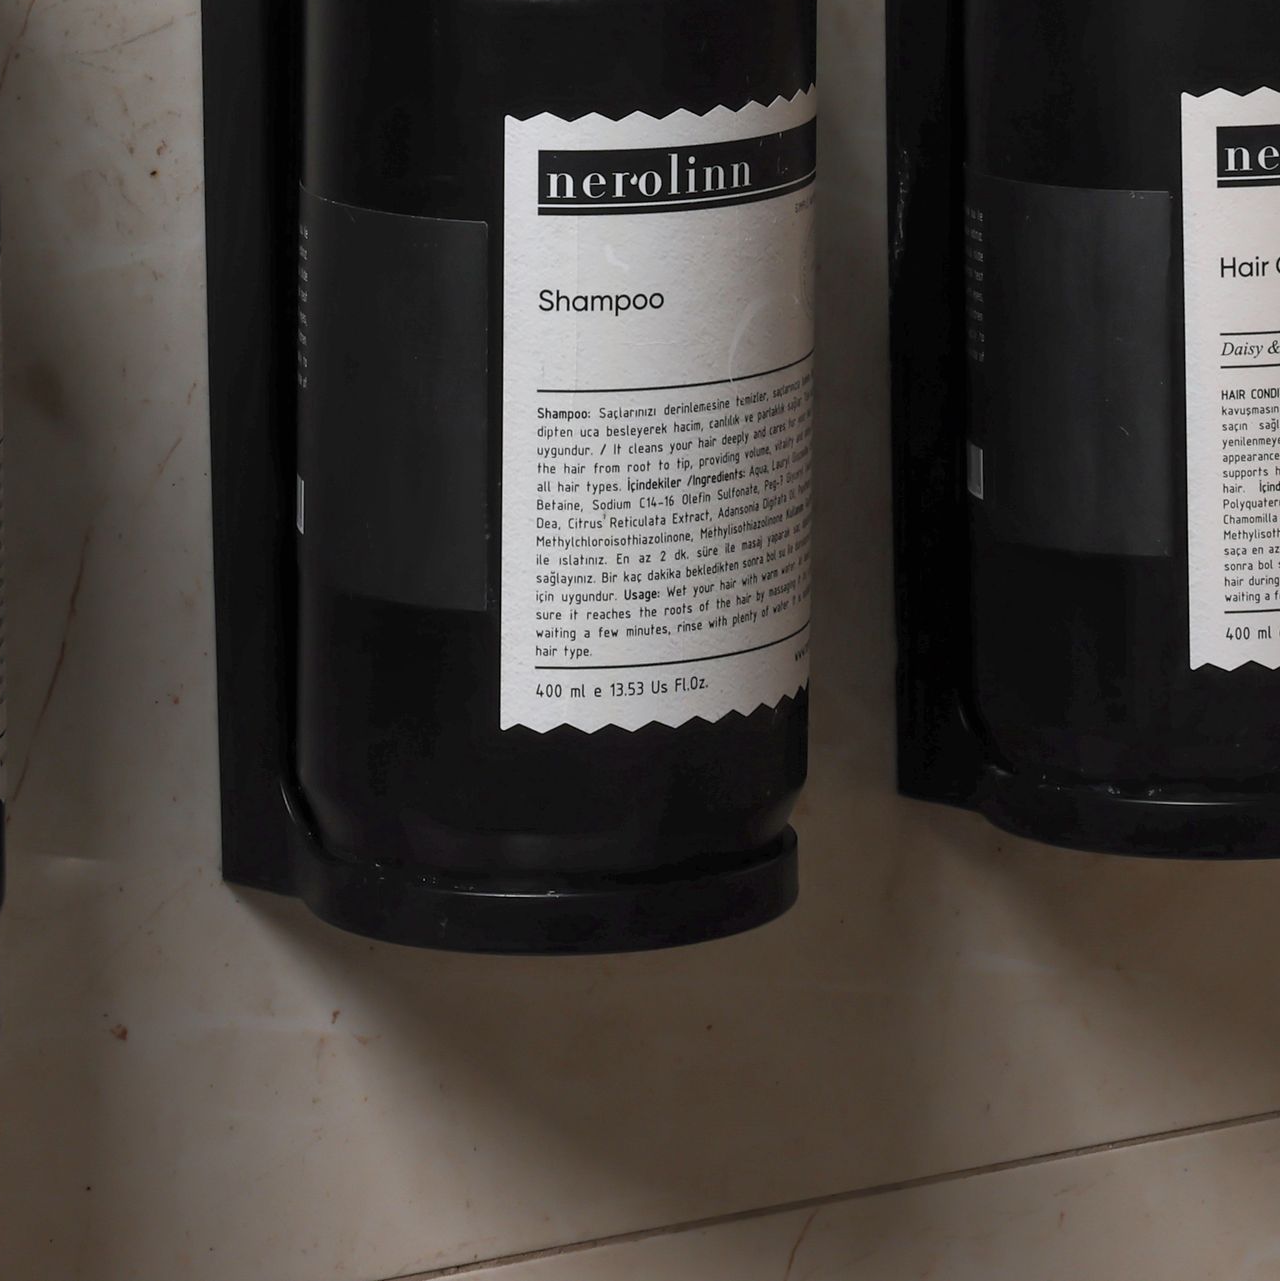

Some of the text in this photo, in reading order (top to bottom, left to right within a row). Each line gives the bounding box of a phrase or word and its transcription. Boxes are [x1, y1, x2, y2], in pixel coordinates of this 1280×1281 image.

[546, 152, 753, 200] nerolinn
[1220, 257, 1270, 278] Hair
[538, 289, 665, 317] Shampoo
[1221, 341, 1264, 359] Daisy
[1267, 339, 1280, 355] &
[1221, 388, 1246, 401] HAIR
[537, 407, 591, 423] Shampoo:
[537, 422, 668, 441] dipten uca besleyerek
[536, 442, 664, 459] uygundur. It cleans
[537, 462, 621, 475] the hair from
[1222, 466, 1269, 480] supports
[536, 480, 551, 493] all
[557, 481, 580, 493] hair
[586, 480, 622, 496] types.
[536, 495, 675, 513] Betaine, Sodium C14-16
[536, 514, 666, 531] Dea, Citrus Reticulata
[1223, 512, 1278, 525] Chamomilla
[1251, 546, 1264, 555] en
[1268, 545, 1280, 554] az
[536, 553, 550, 566] ile
[616, 552, 630, 565] En
[1224, 562, 1254, 572] sonra
[1257, 559, 1273, 571] bol
[601, 571, 618, 584] Bir
[1224, 576, 1244, 587] hair
[1248, 575, 1280, 588] during
[561, 590, 618, 606] uygundur.
[623, 588, 660, 603] Usage:
[1224, 591, 1261, 604] waiting
[1264, 592, 1271, 601] a
[535, 607, 632, 621] sure it reaches
[535, 626, 619, 642] waiting a few
[1225, 626, 1251, 641] 400
[1257, 625, 1272, 640] ml
[535, 645, 592, 660] hair type.
[535, 675, 709, 699] 400 ml e 13.53 Us Fl.Oz.
